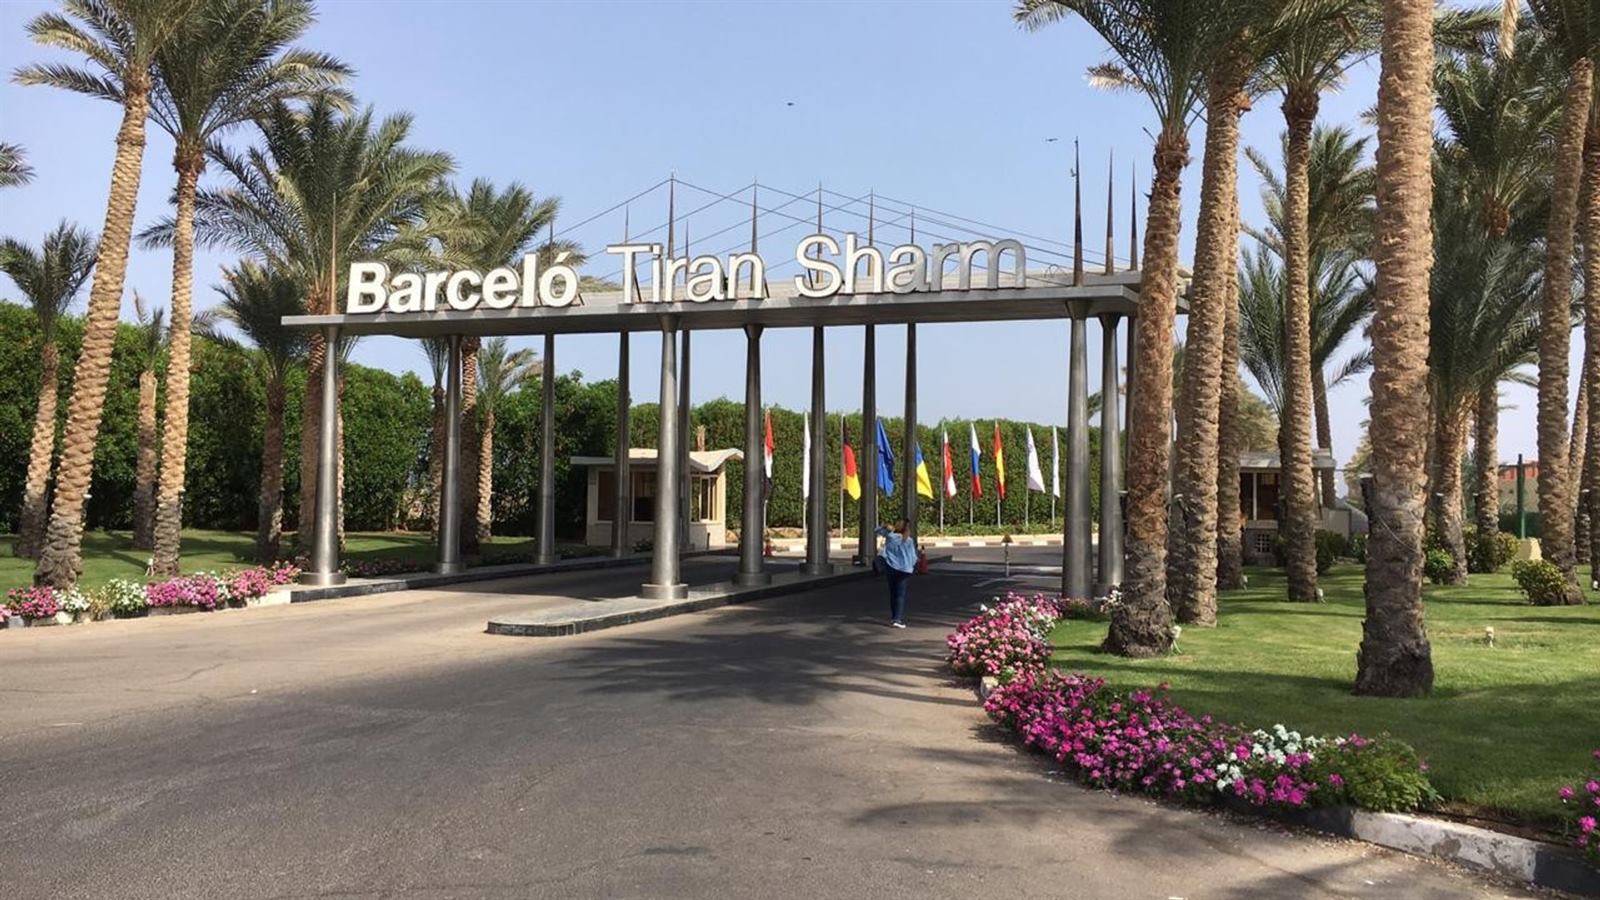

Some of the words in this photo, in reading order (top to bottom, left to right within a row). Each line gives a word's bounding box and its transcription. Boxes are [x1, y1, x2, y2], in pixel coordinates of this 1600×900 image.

[346, 252, 580, 314] Barceló
[606, 243, 767, 304] Tiran
[795, 232, 1026, 299] Sharm
